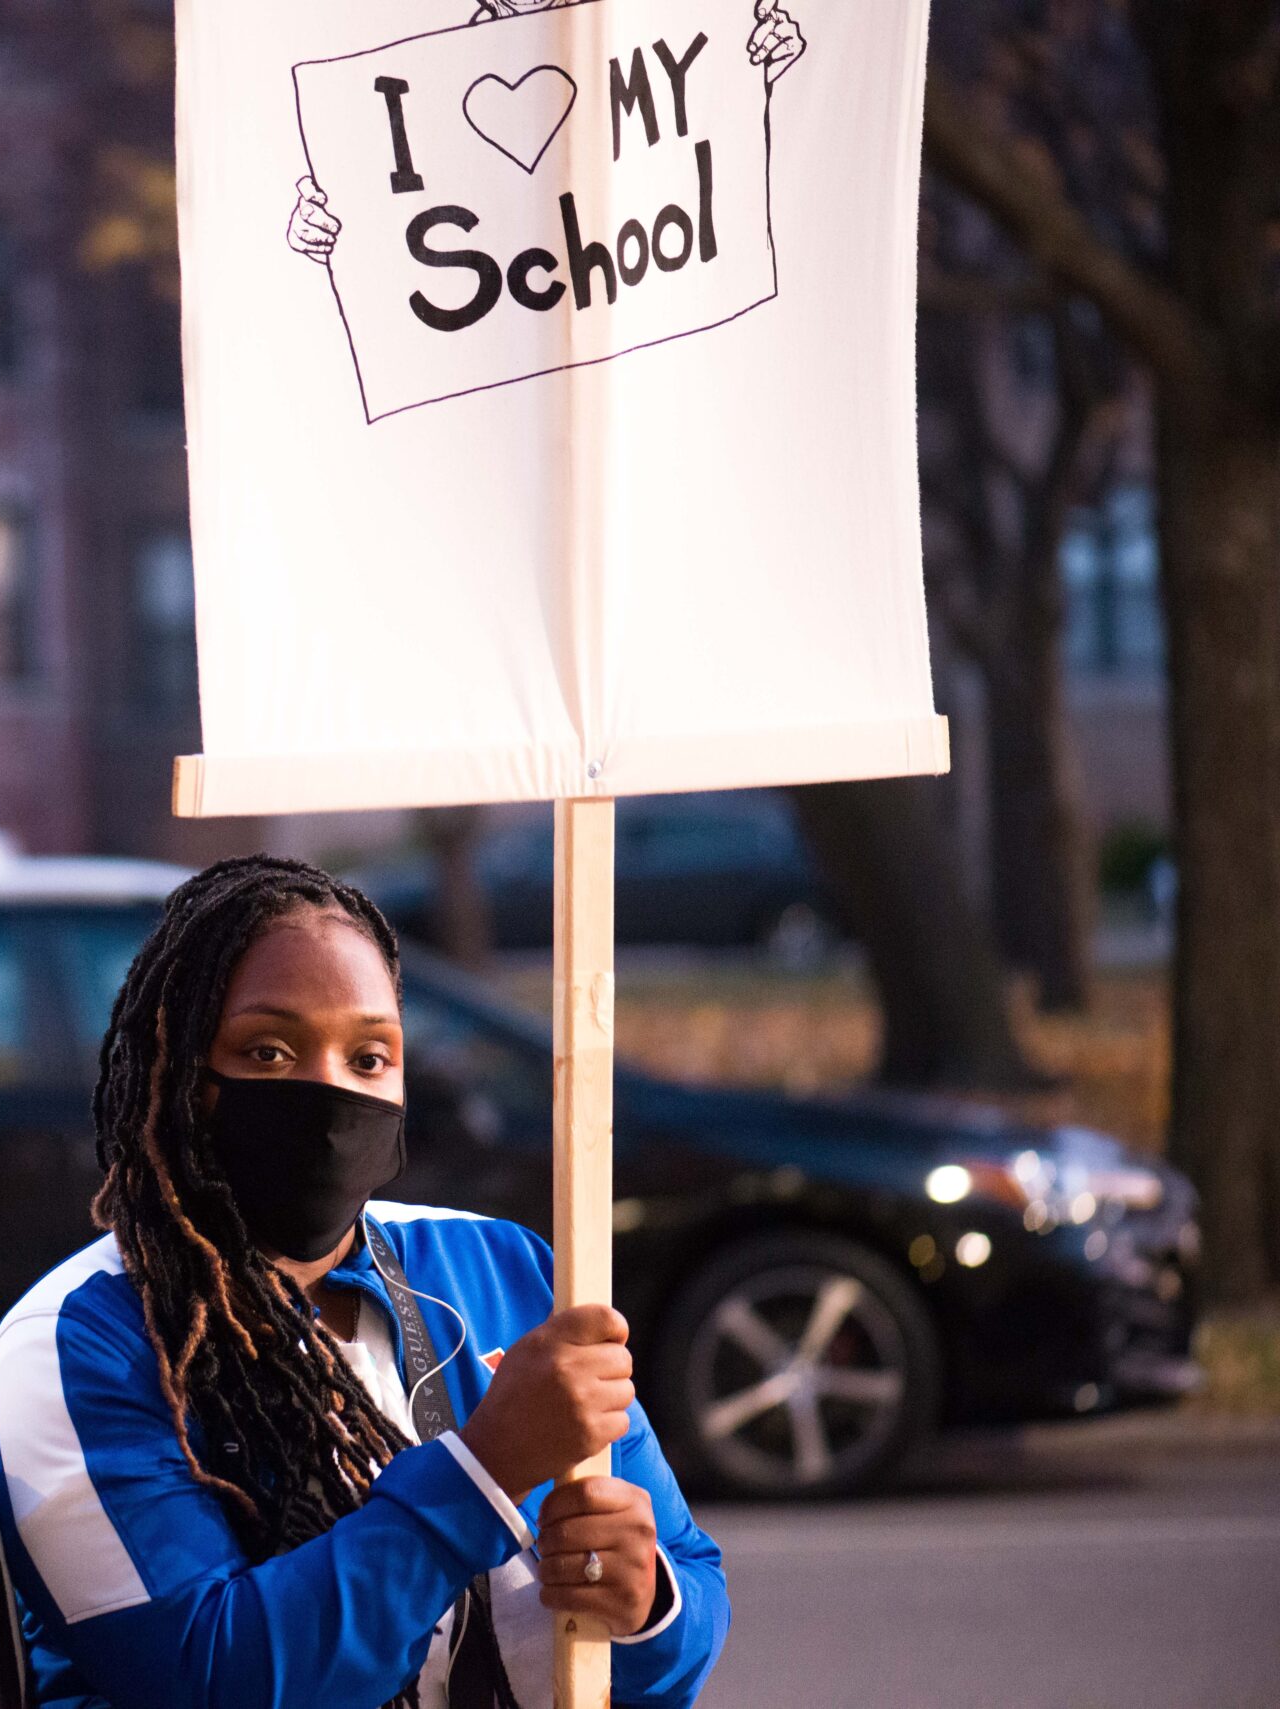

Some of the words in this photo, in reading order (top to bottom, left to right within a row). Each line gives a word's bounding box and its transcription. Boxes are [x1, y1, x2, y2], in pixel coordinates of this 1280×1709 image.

[374, 75, 425, 194] I
[609, 31, 708, 162] MY
[405, 139, 718, 332] School
[393, 1290, 428, 1373] GUESS
